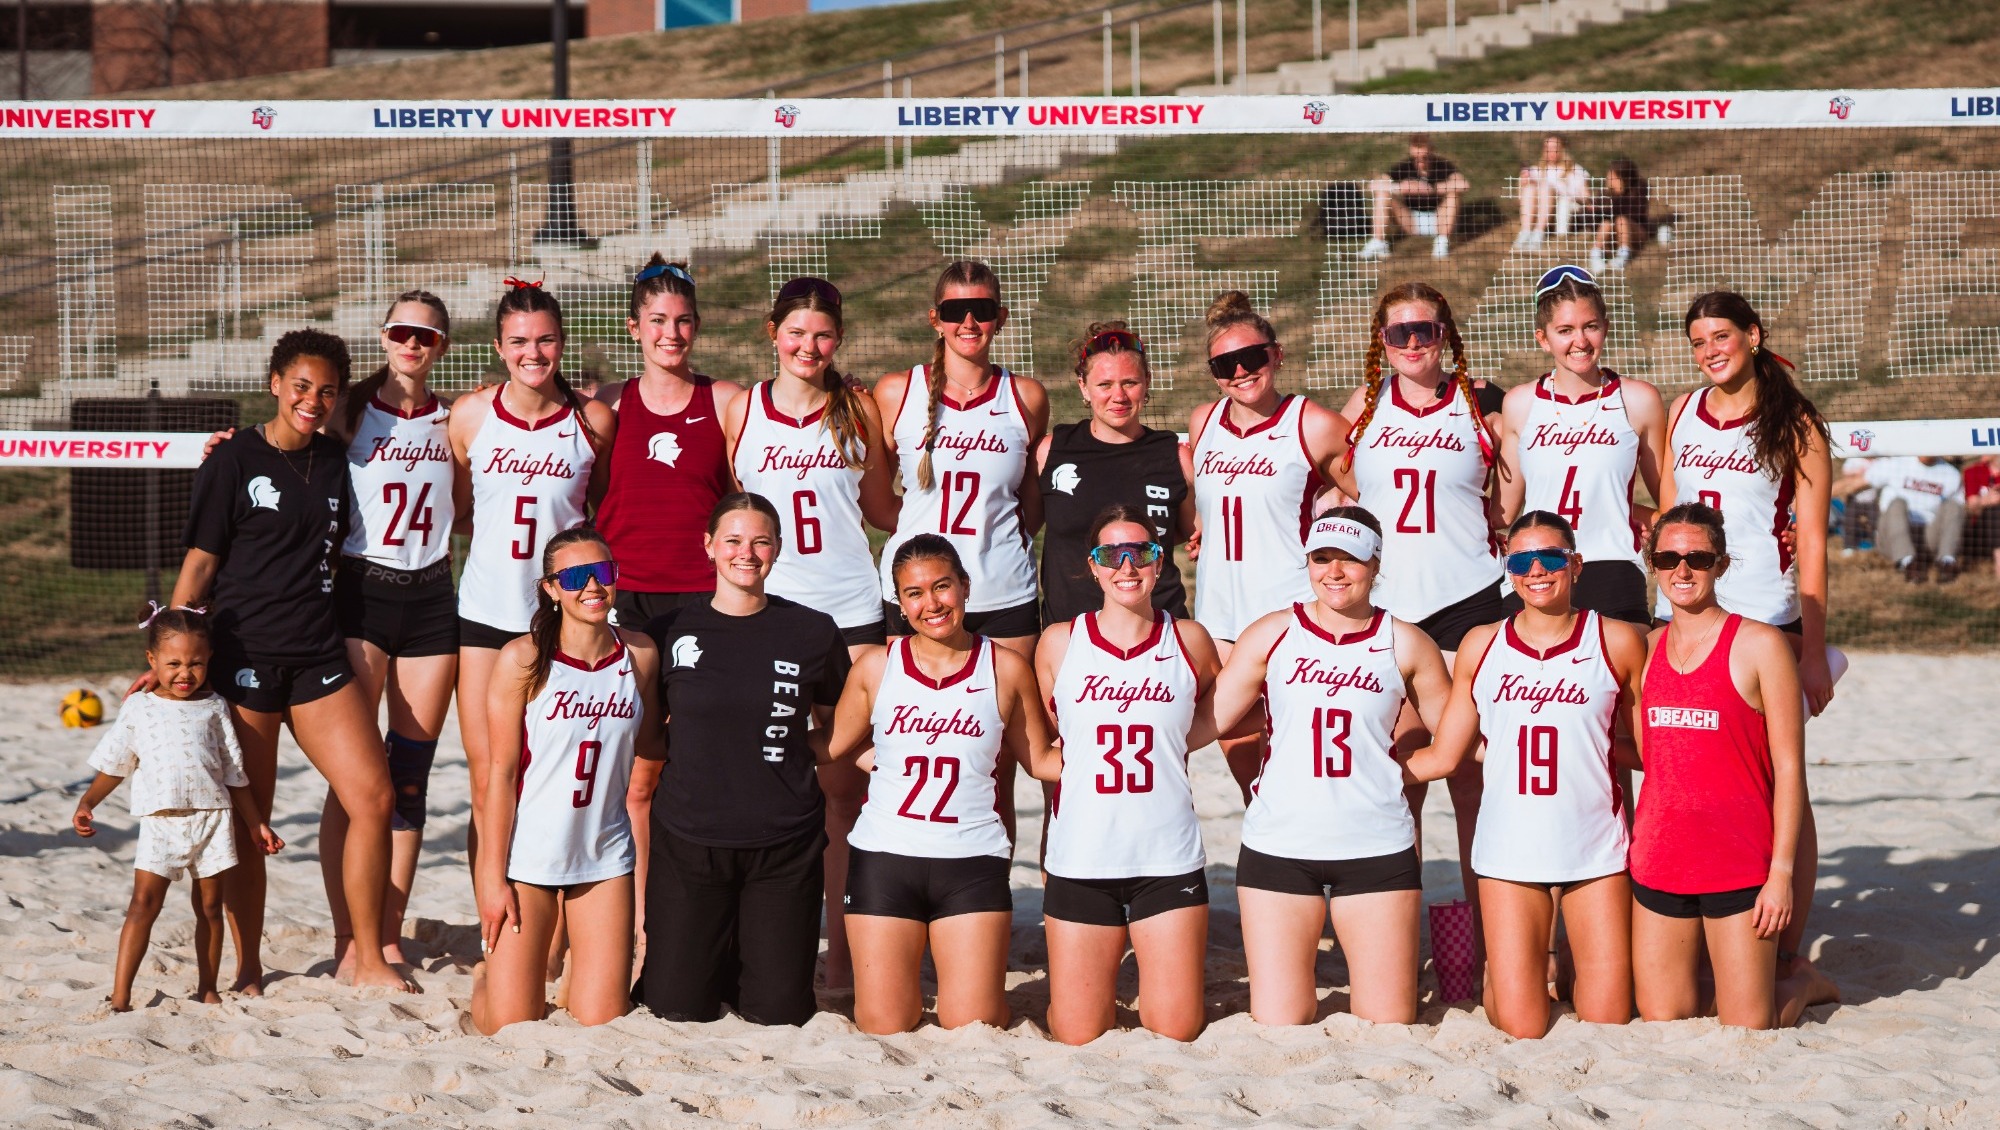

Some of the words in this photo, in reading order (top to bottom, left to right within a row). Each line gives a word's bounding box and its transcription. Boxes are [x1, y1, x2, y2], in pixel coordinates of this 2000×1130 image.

[0, 108, 155, 129] NIVERSITY
[374, 108, 494, 129] LIBERTY
[501, 106, 677, 130] UNIVERSITY
[898, 106, 1020, 126] LIBERTY
[1027, 103, 1205, 126] UNIVERSITY
[1426, 101, 1547, 122] LIBERTY
[1556, 98, 1732, 121] UNIVERSITY
[1951, 96, 2000, 117] LIB
[0, 439, 170, 459] UNIVERSITY
[365, 437, 450, 472] Knights
[1370, 427, 1465, 457] Knights
[1527, 423, 1619, 457] Knights
[483, 447, 575, 485] Knights
[757, 445, 848, 480] Knights
[1198, 450, 1277, 486] Knights
[1673, 444, 1760, 480] Knights
[383, 483, 432, 547] 24
[939, 471, 980, 536] 12
[1394, 468, 1436, 534] 21
[1557, 465, 1583, 530] 4
[511, 496, 537, 560] 5
[793, 490, 822, 555] 6
[1222, 496, 1243, 562] 11
[1325, 523, 1361, 537] BEACH
[319, 497, 339, 593] BEACH
[366, 565, 412, 585] PRO
[1076, 675, 1174, 713] Knights
[1286, 657, 1384, 697] Knights
[1493, 674, 1589, 714] Knights
[547, 691, 636, 729] Knights
[762, 660, 800, 762] BEACH
[885, 705, 984, 745] Knights
[1660, 709, 1717, 728] BEACH
[1096, 724, 1154, 794] 33
[1311, 708, 1353, 778] 13
[1517, 725, 1558, 796] 19
[572, 741, 602, 808] 9
[898, 756, 959, 824] 22
